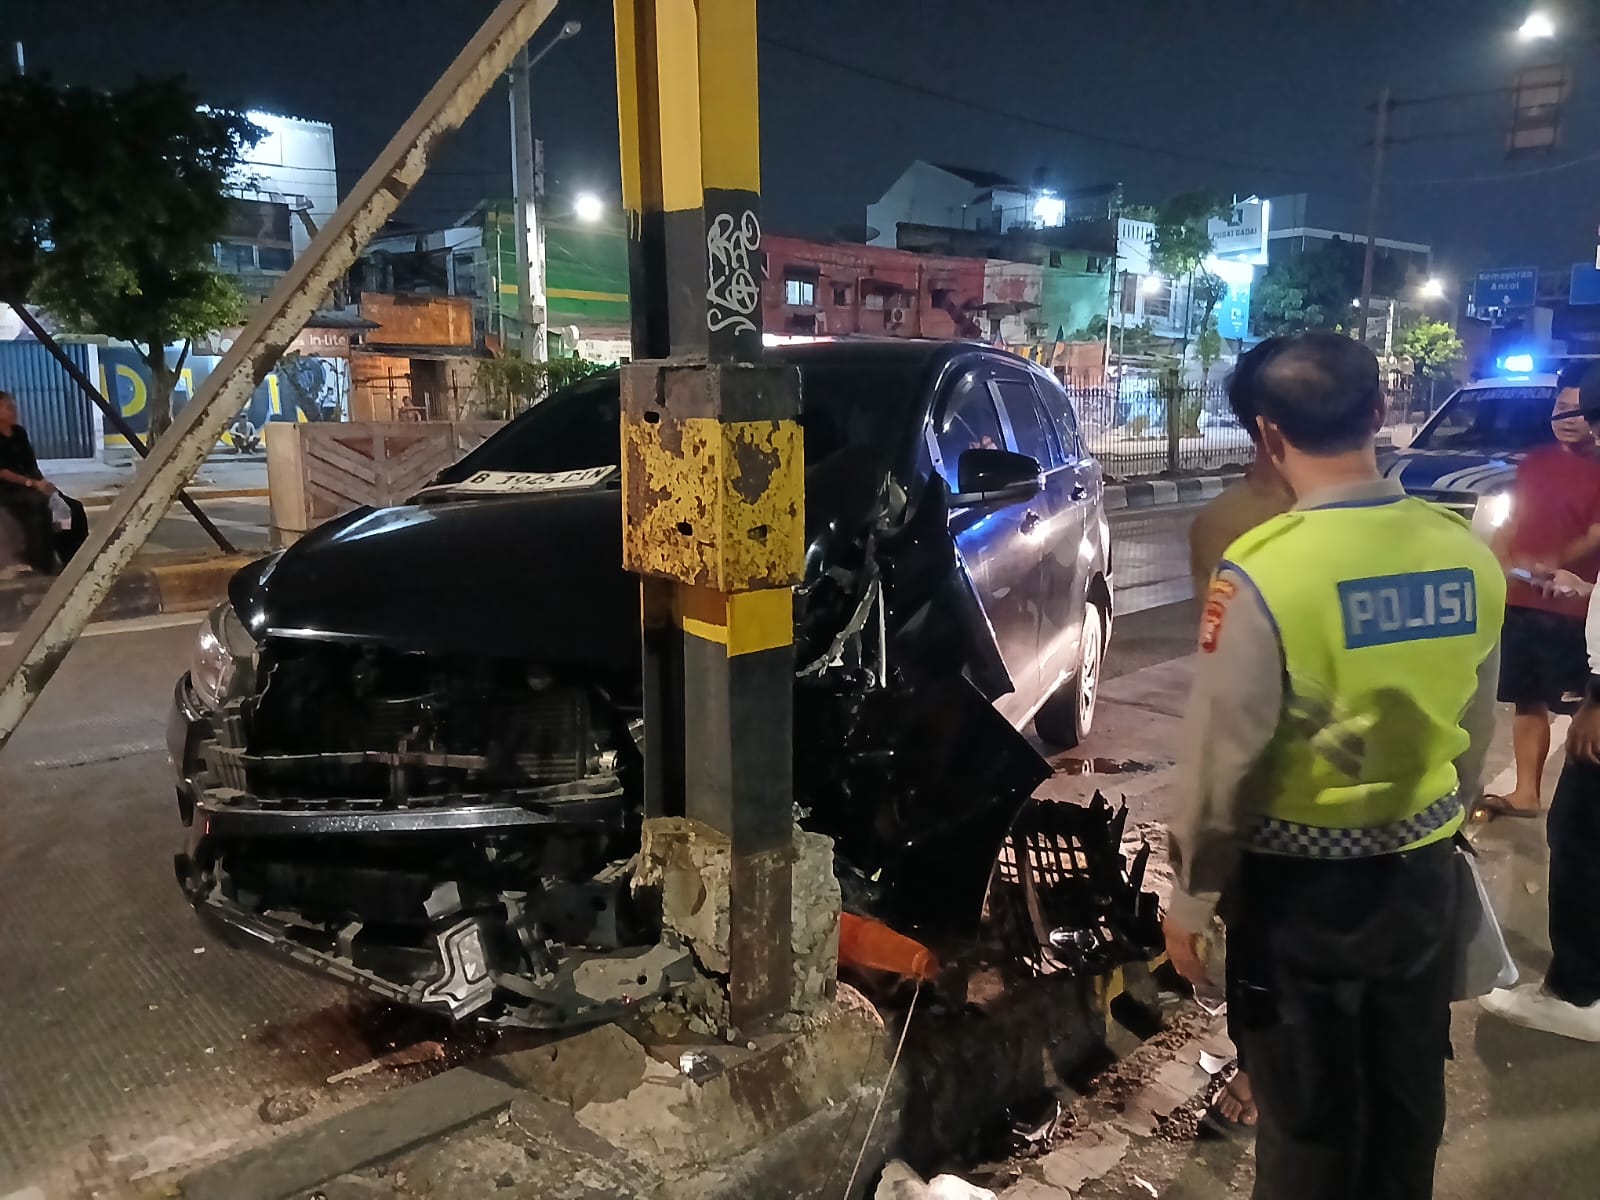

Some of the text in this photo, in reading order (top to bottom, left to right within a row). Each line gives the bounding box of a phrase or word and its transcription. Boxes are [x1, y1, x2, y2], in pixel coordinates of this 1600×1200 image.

[1479, 271, 1533, 281] Kemayoran
[1490, 281, 1520, 291] Ancol
[470, 472, 491, 485] B
[1349, 581, 1474, 635] POLISI
